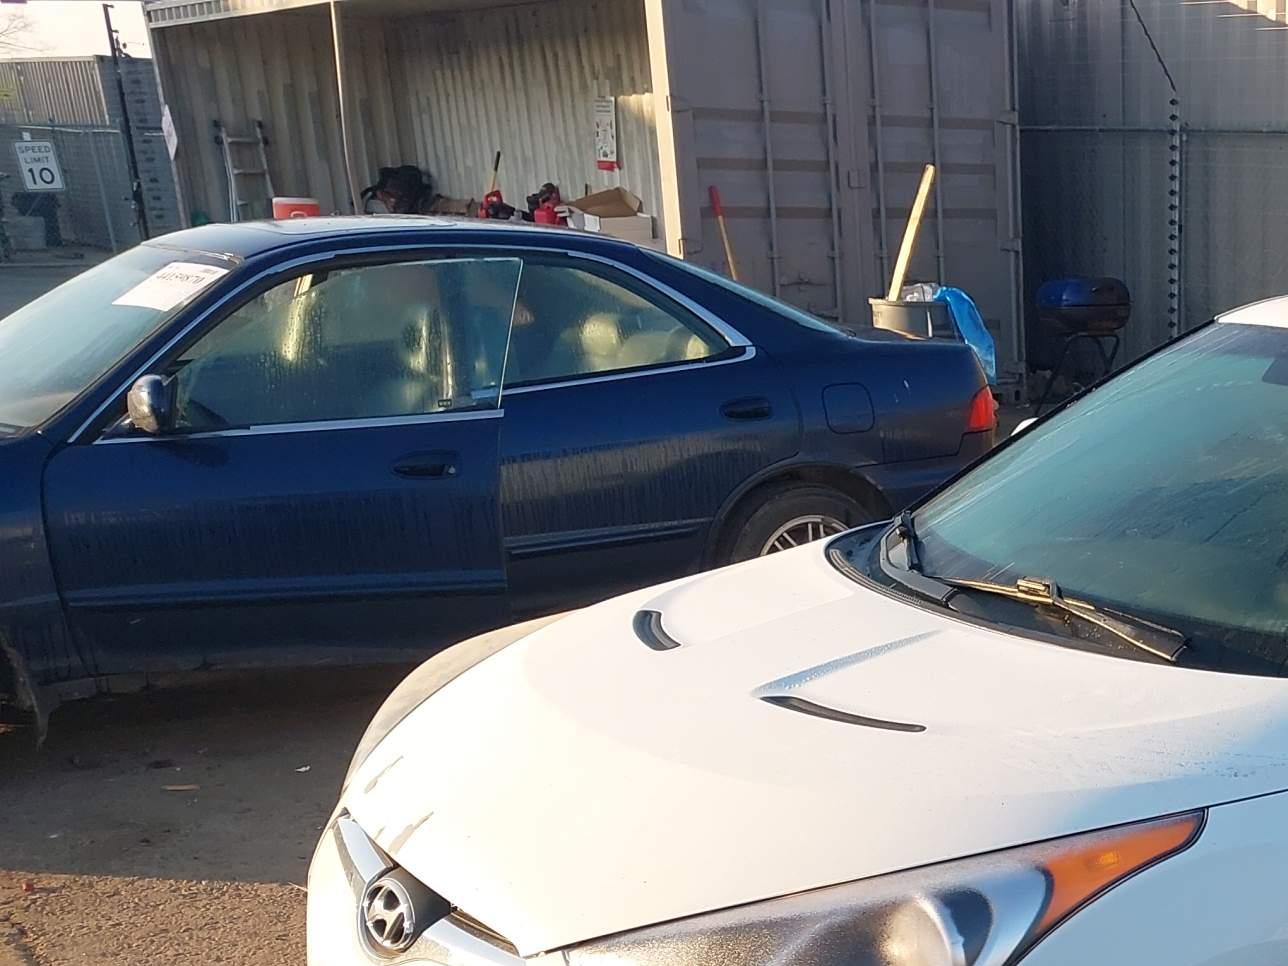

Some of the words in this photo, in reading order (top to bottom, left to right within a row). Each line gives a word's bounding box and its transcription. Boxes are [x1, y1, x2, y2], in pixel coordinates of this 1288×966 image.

[18, 145, 51, 154] SPEED
[24, 156, 50, 165] LIMIT
[28, 167, 55, 185] 10
